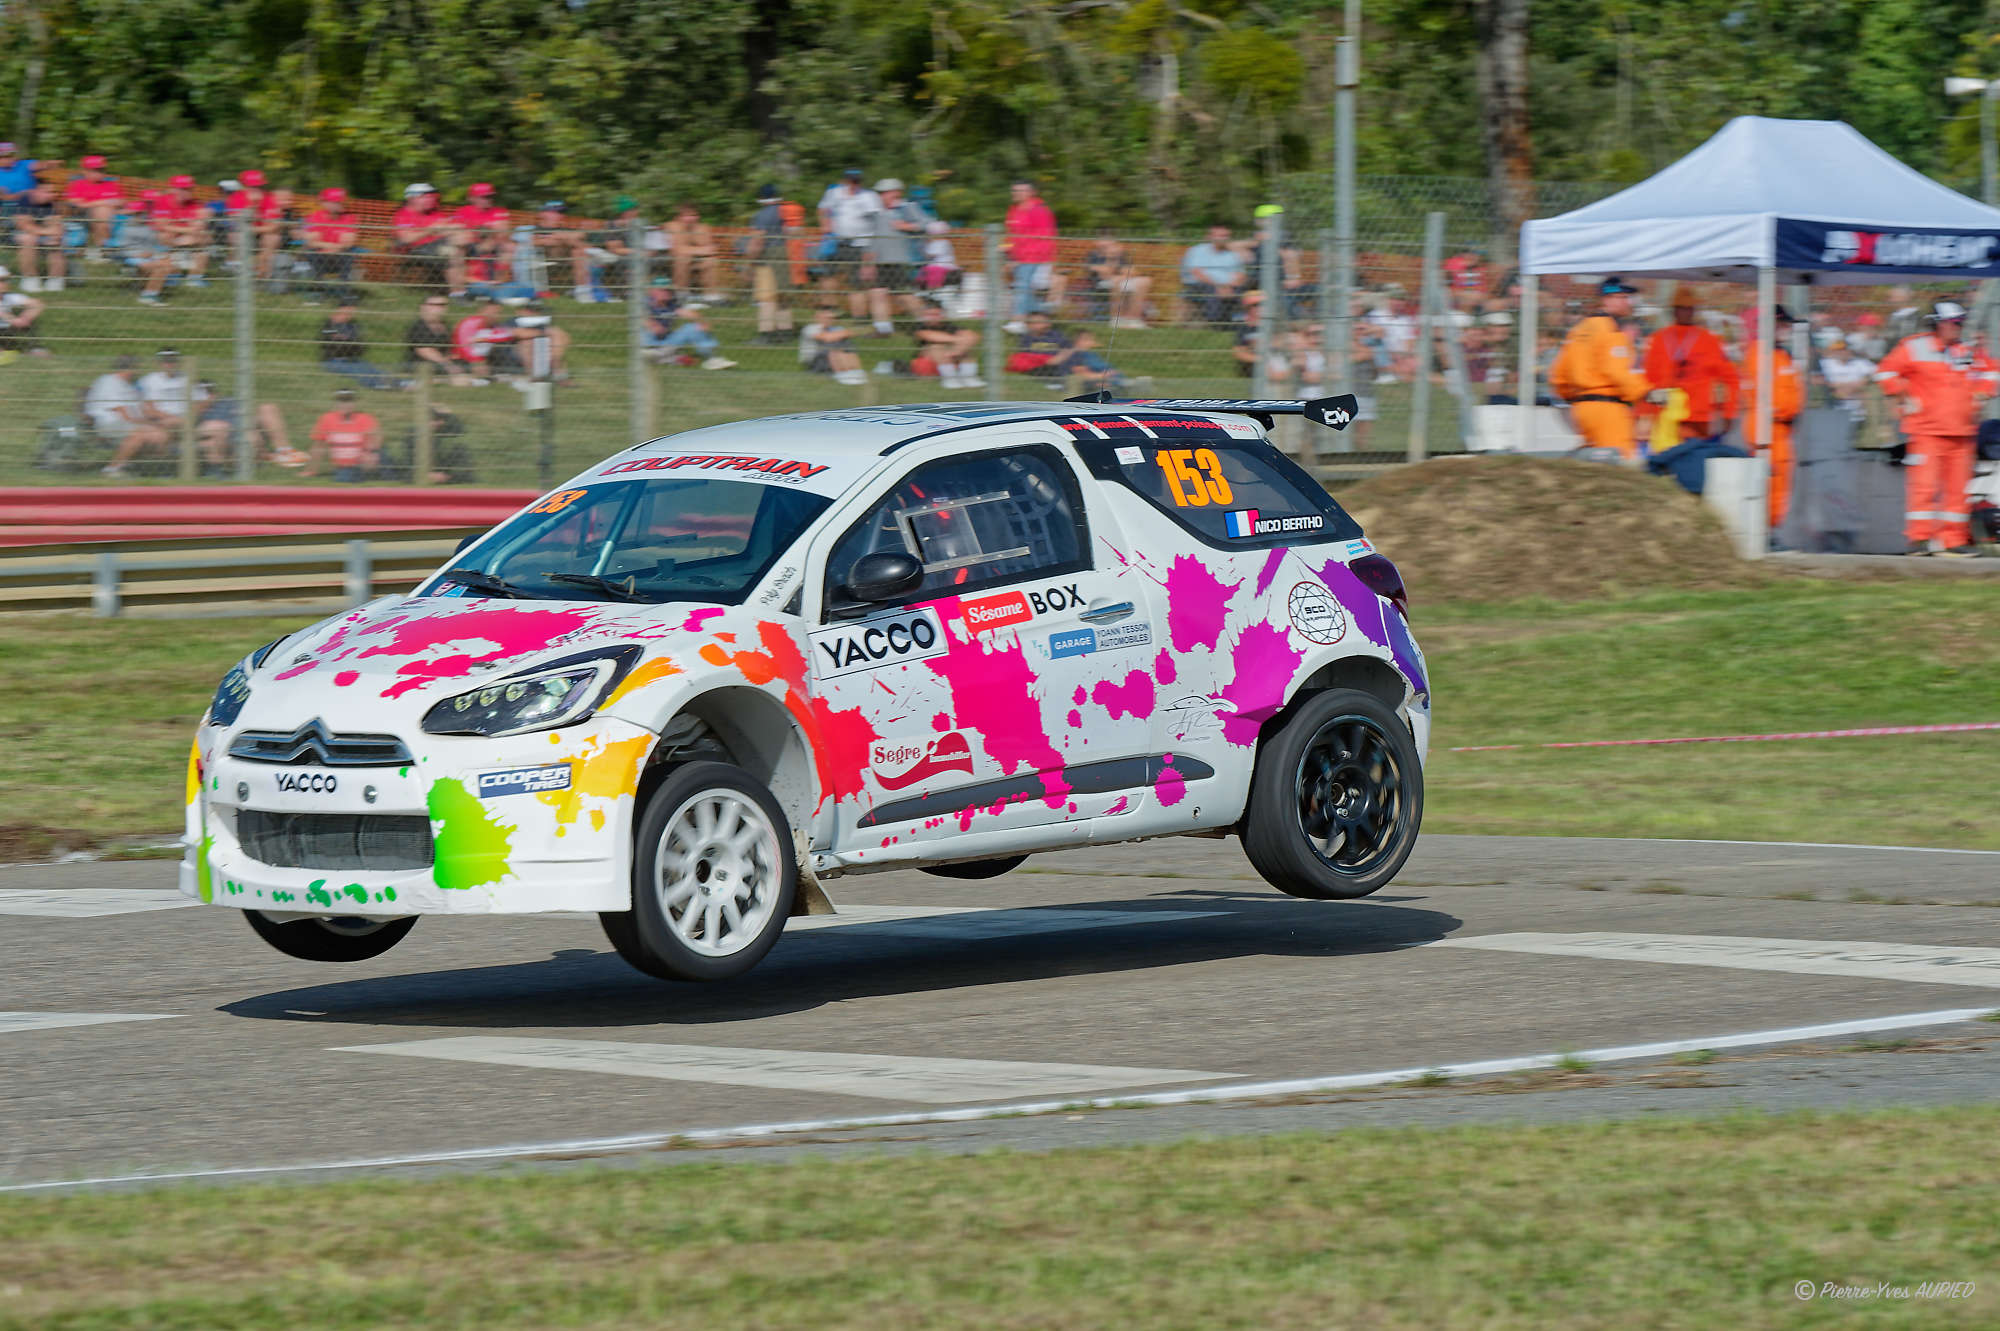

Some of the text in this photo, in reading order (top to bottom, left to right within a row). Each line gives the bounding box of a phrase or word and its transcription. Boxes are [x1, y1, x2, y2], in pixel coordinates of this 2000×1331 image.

[598, 455, 830, 478] COUPTRAIN
[1155, 447, 1234, 507] 153
[1254, 515, 1323, 534] NICO BERTHO
[967, 583, 1087, 625] Sésame BOX
[1121, 622, 1149, 634] TESSON
[819, 618, 936, 668] YACCO
[1054, 636, 1092, 651] GARAGE
[1099, 633, 1149, 647] AUTOMOBILES
[275, 773, 337, 793] YACCO
[480, 767, 571, 788] COOPER
[522, 780, 569, 792] TIRES
